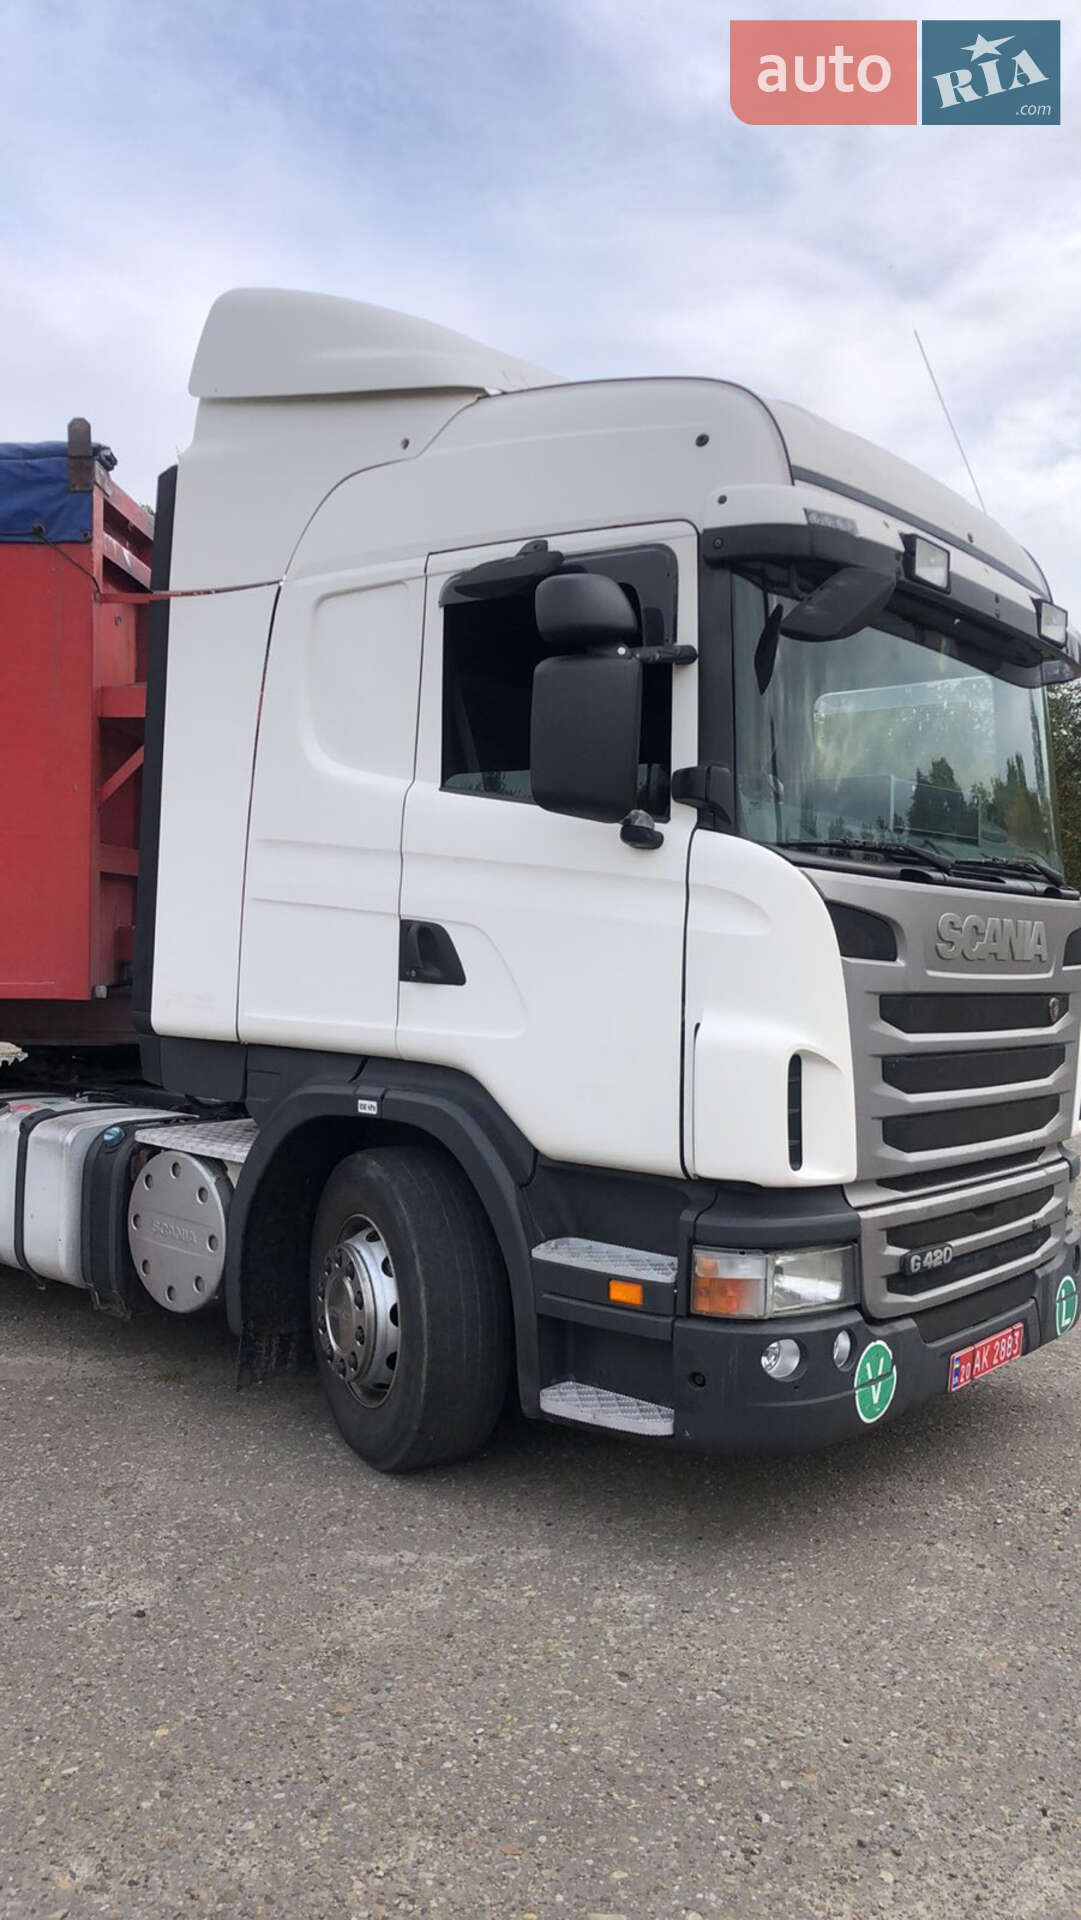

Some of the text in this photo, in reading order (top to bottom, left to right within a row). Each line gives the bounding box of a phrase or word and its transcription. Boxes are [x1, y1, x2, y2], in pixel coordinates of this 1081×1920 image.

[935, 912, 1049, 963] SCANIA
[151, 1219, 198, 1243] SCANIA
[960, 1331, 1020, 1383] 20 AK 2883
